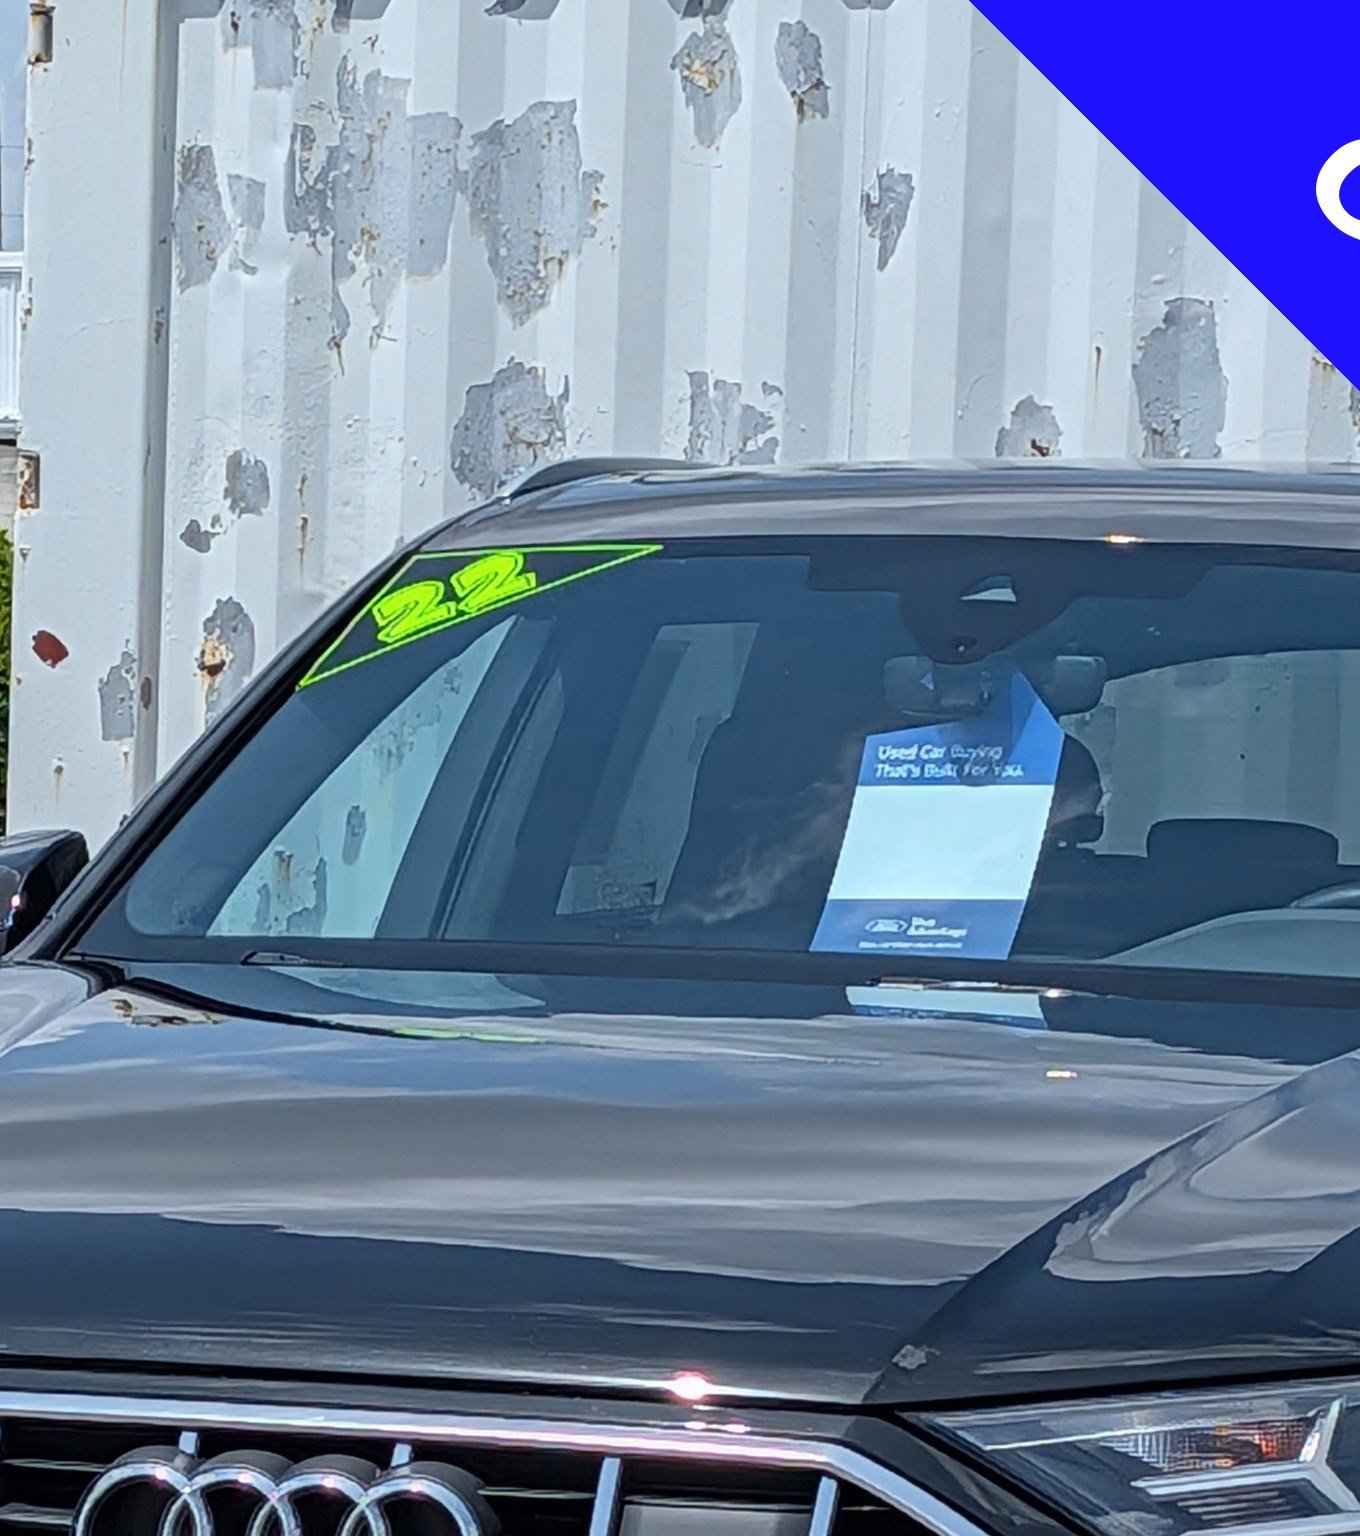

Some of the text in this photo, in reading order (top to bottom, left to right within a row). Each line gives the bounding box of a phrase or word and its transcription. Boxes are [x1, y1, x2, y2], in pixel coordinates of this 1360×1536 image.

[372, 550, 537, 643] 22
[877, 744, 918, 760] Used
[919, 744, 947, 760] Car
